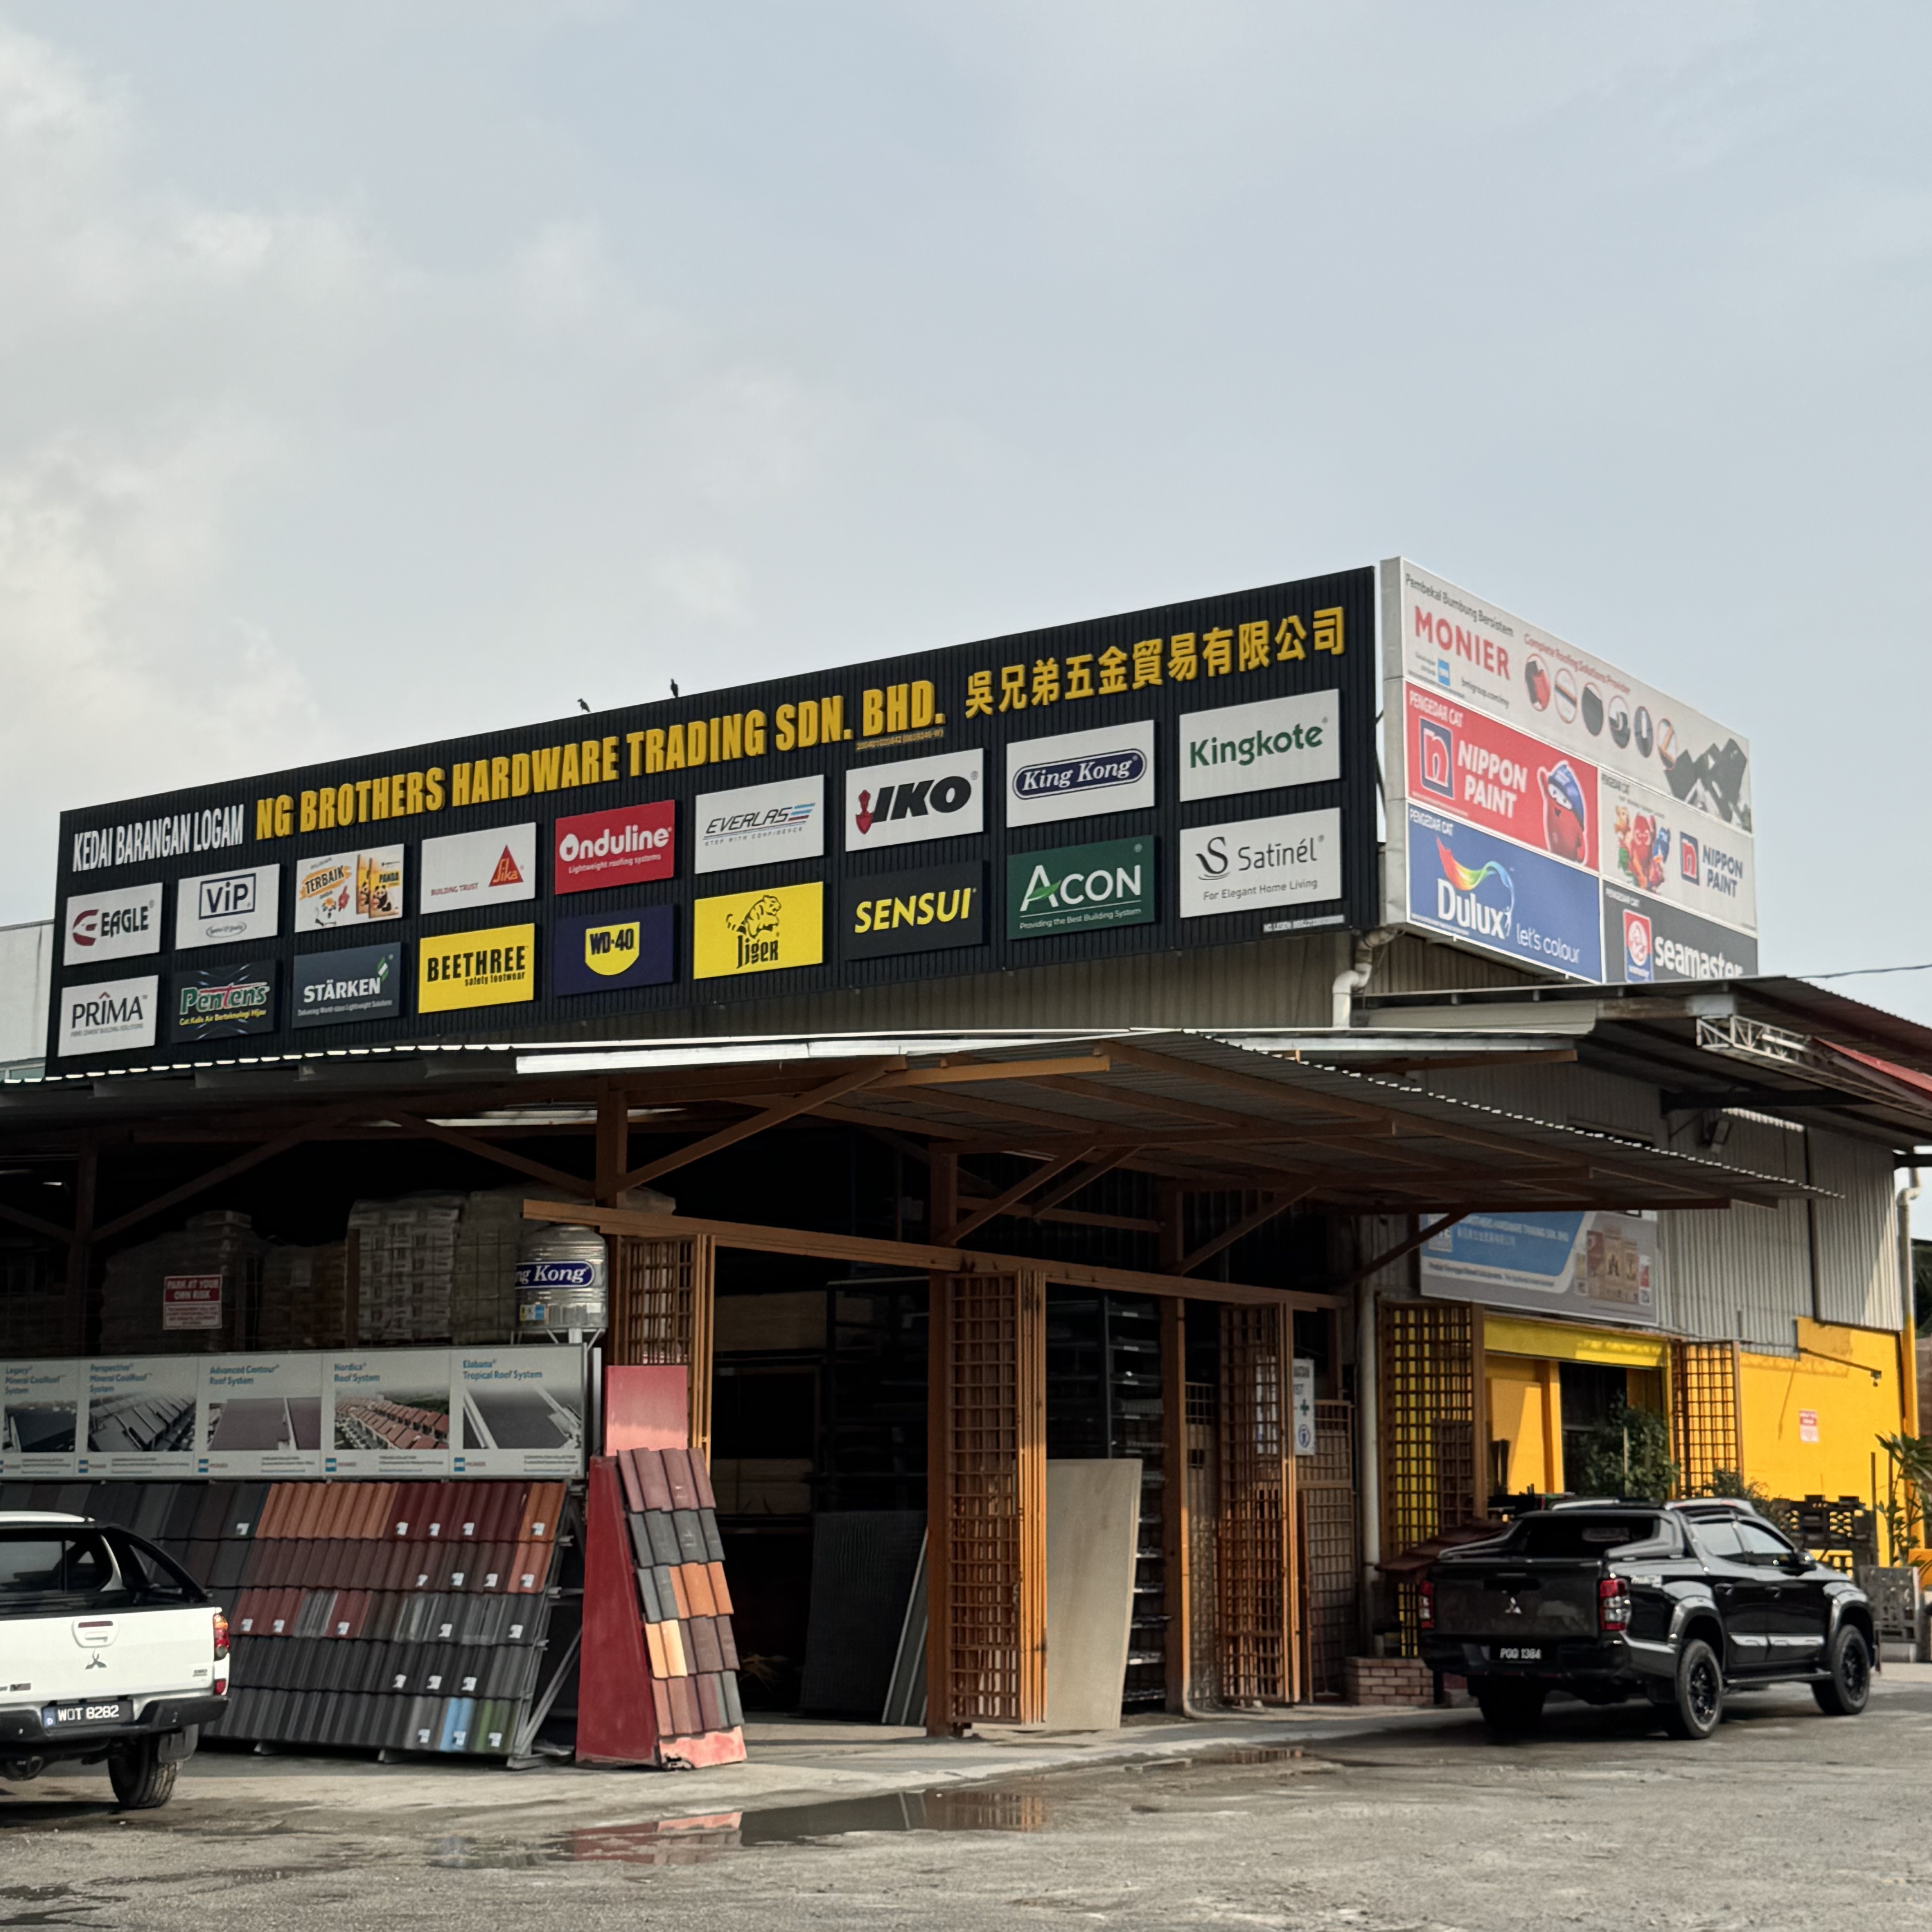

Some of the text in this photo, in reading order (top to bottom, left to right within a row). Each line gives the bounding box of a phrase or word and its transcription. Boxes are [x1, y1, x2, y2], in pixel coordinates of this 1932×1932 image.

[1414, 605, 1510, 681] MONIER
[965, 606, 1345, 719] 吳兄弟五金貿易有限公司
[1409, 690, 1464, 728] PENGEDAR CAT
[256, 680, 946, 840] NG BROTHERS HARDWARE TRADING SDN. BHD.
[1189, 723, 1324, 768] Kingkote
[1021, 759, 1133, 793] King Kong
[1458, 741, 1527, 793] NIPPON
[871, 775, 971, 824] IKO
[1464, 775, 1517, 819] PAINT
[72, 804, 244, 872] KEDAI BARANGAN LOGAM
[559, 825, 670, 863] Onduline
[492, 858, 518, 884] Sika
[568, 861, 608, 874] Lightweight
[1702, 845, 1743, 879] NIPPON
[305, 865, 345, 894] TERBAIK
[459, 883, 478, 892] TRUST
[1204, 880, 1318, 901] For Elegant Home Living
[1706, 870, 1737, 897] PAINT
[101, 906, 149, 937] EAGLE
[855, 888, 971, 934] SENSUI
[1019, 921, 1052, 930] Providing
[1067, 915, 1082, 924] Best
[1084, 910, 1113, 922] Building
[1437, 879, 1506, 940] Dulux
[1516, 923, 1580, 965] let's colour
[1655, 936, 1743, 979] seamaster
[427, 946, 526, 983] BEETHREE
[465, 971, 526, 987] safety footwear
[179, 982, 269, 1015] Pentens
[303, 977, 381, 1003] STÄRKEN
[534, 1265, 585, 1283] Kong
[209, 1376, 254, 1387] Roof System
[210, 1366, 245, 1375] Advanced
[334, 1373, 380, 1384] Roof System
[463, 1370, 543, 1381] Tropical Roof System
[86, 1704, 120, 1719] 8282
